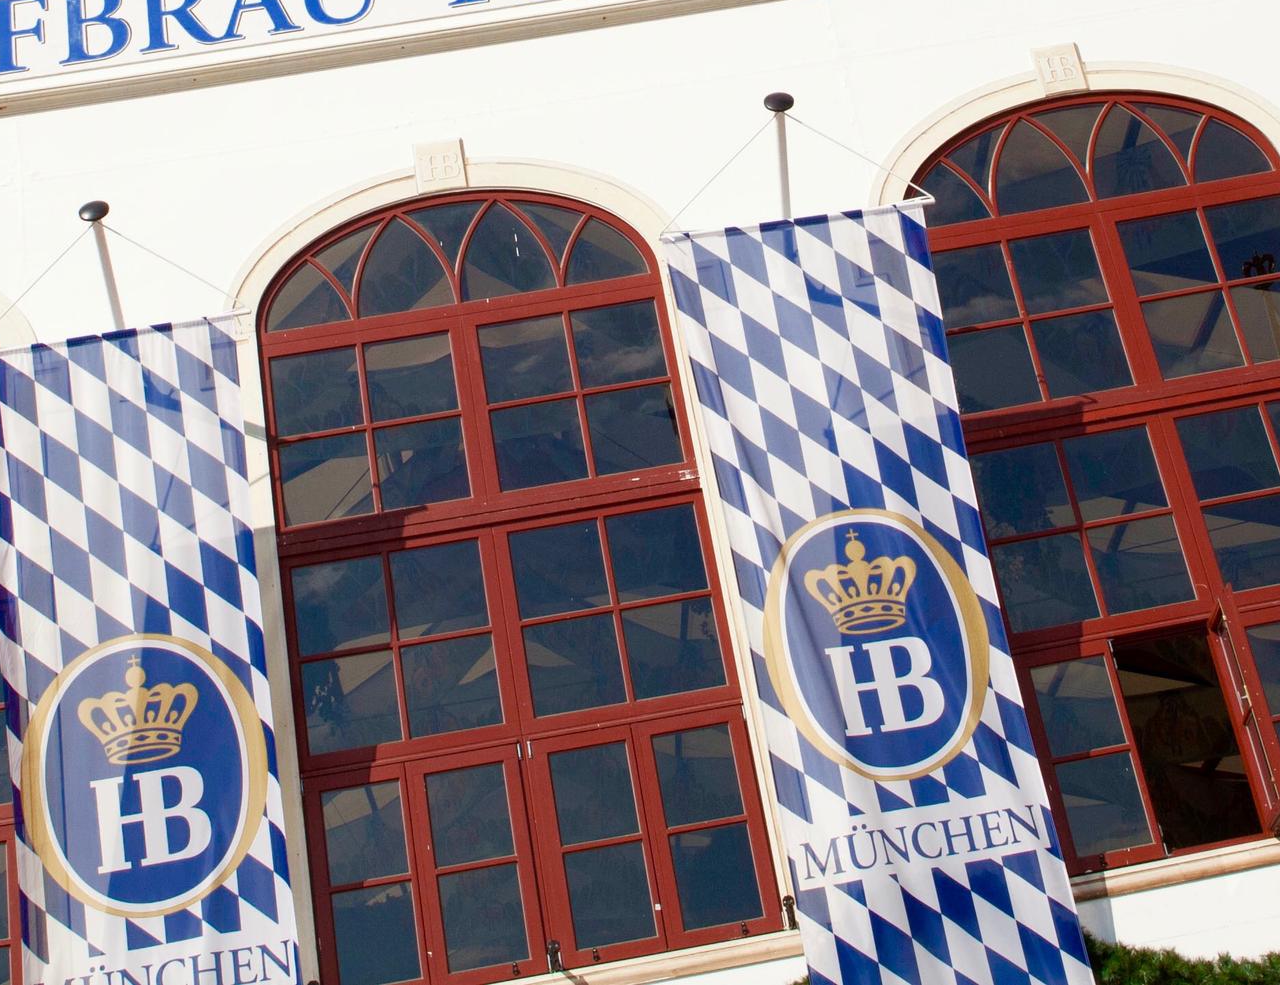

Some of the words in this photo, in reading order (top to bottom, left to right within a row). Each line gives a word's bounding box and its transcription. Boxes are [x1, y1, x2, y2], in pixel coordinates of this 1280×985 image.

[824, 636, 946, 737] HB
[89, 765, 212, 875] HB
[799, 804, 1041, 880] MÜNCHEN
